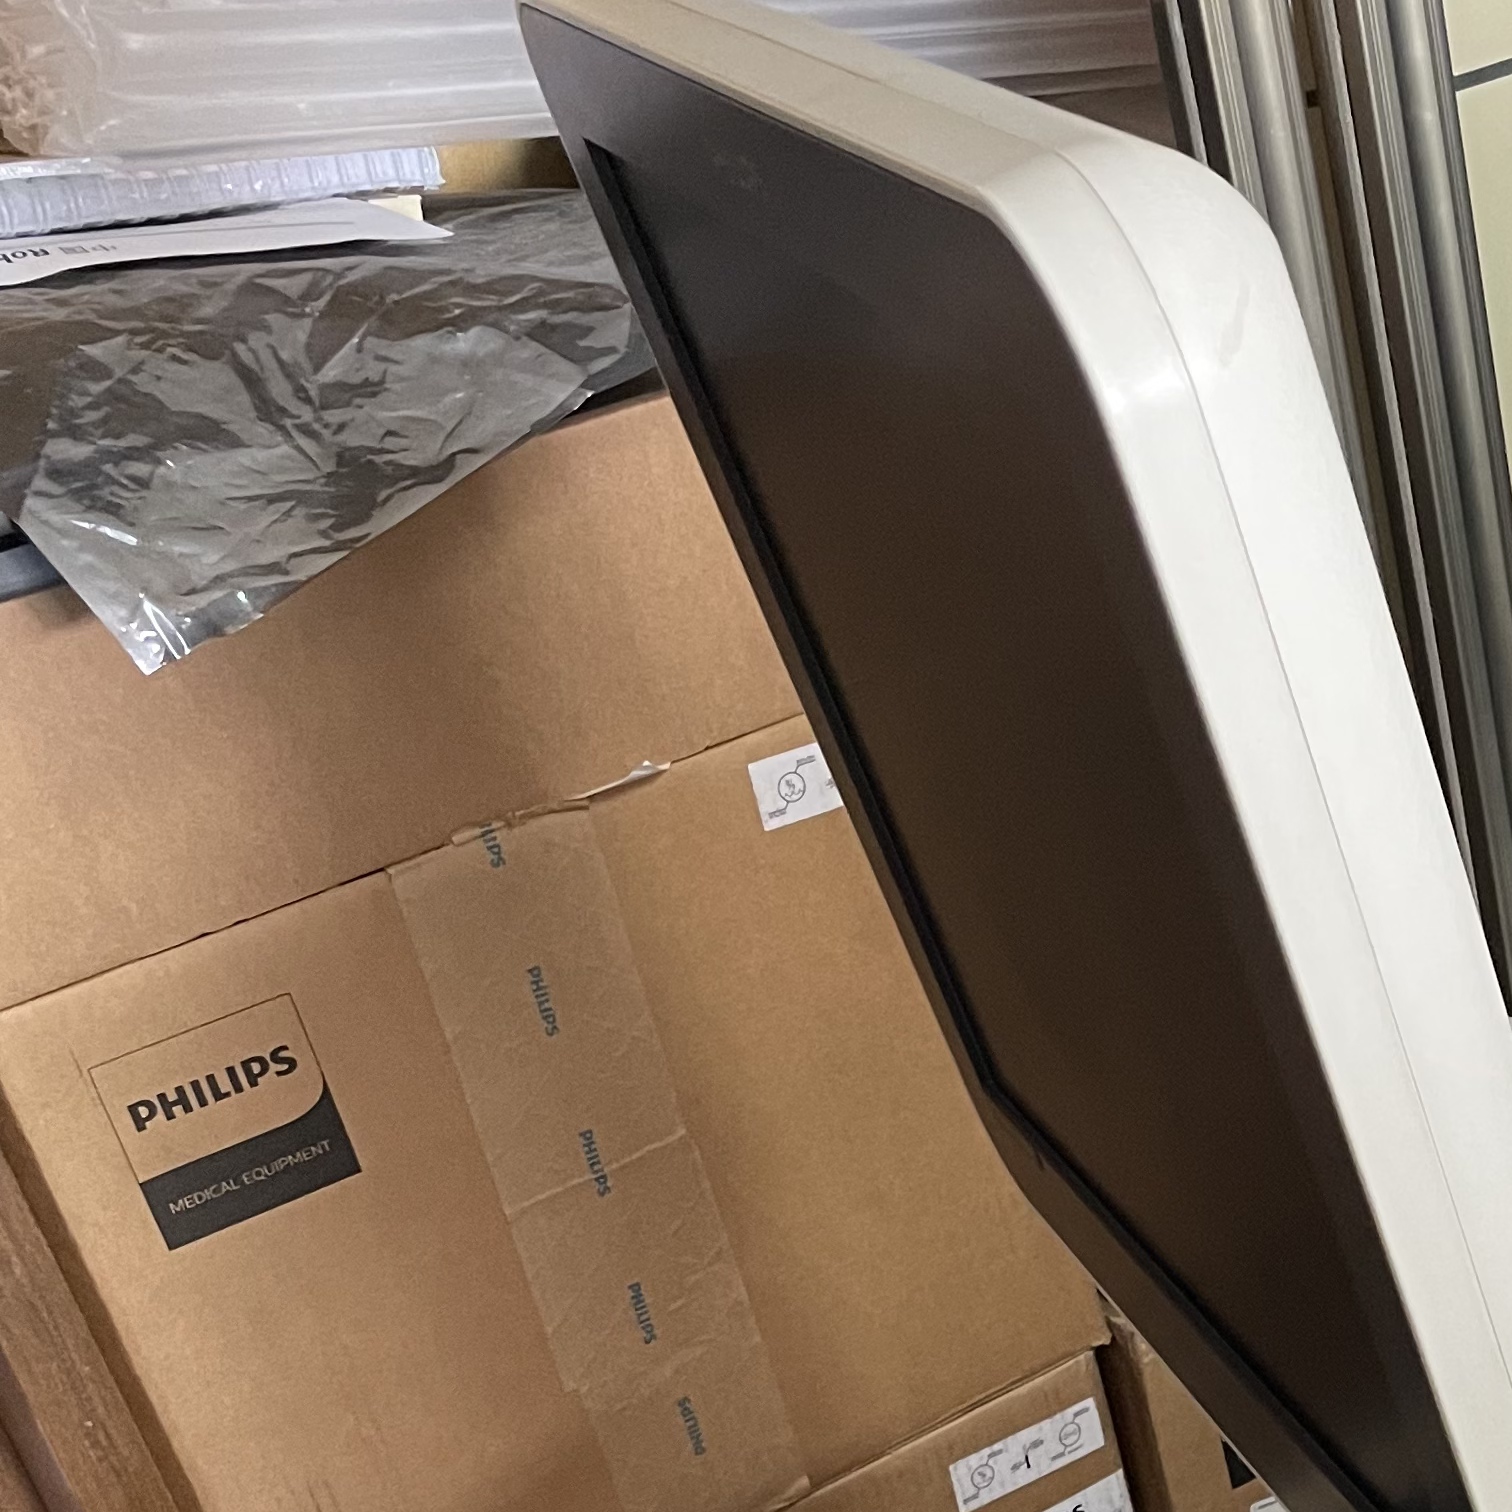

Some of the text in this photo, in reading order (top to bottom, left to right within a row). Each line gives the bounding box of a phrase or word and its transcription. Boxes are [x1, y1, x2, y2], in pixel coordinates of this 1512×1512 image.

[526, 964, 560, 1038] PHILIPS
[127, 1045, 298, 1133] PHILIPS
[169, 1140, 331, 1215] MEDICAL EQUIPMENT
[578, 1129, 612, 1198] PHILIPS
[627, 1281, 657, 1345] PHILIPS
